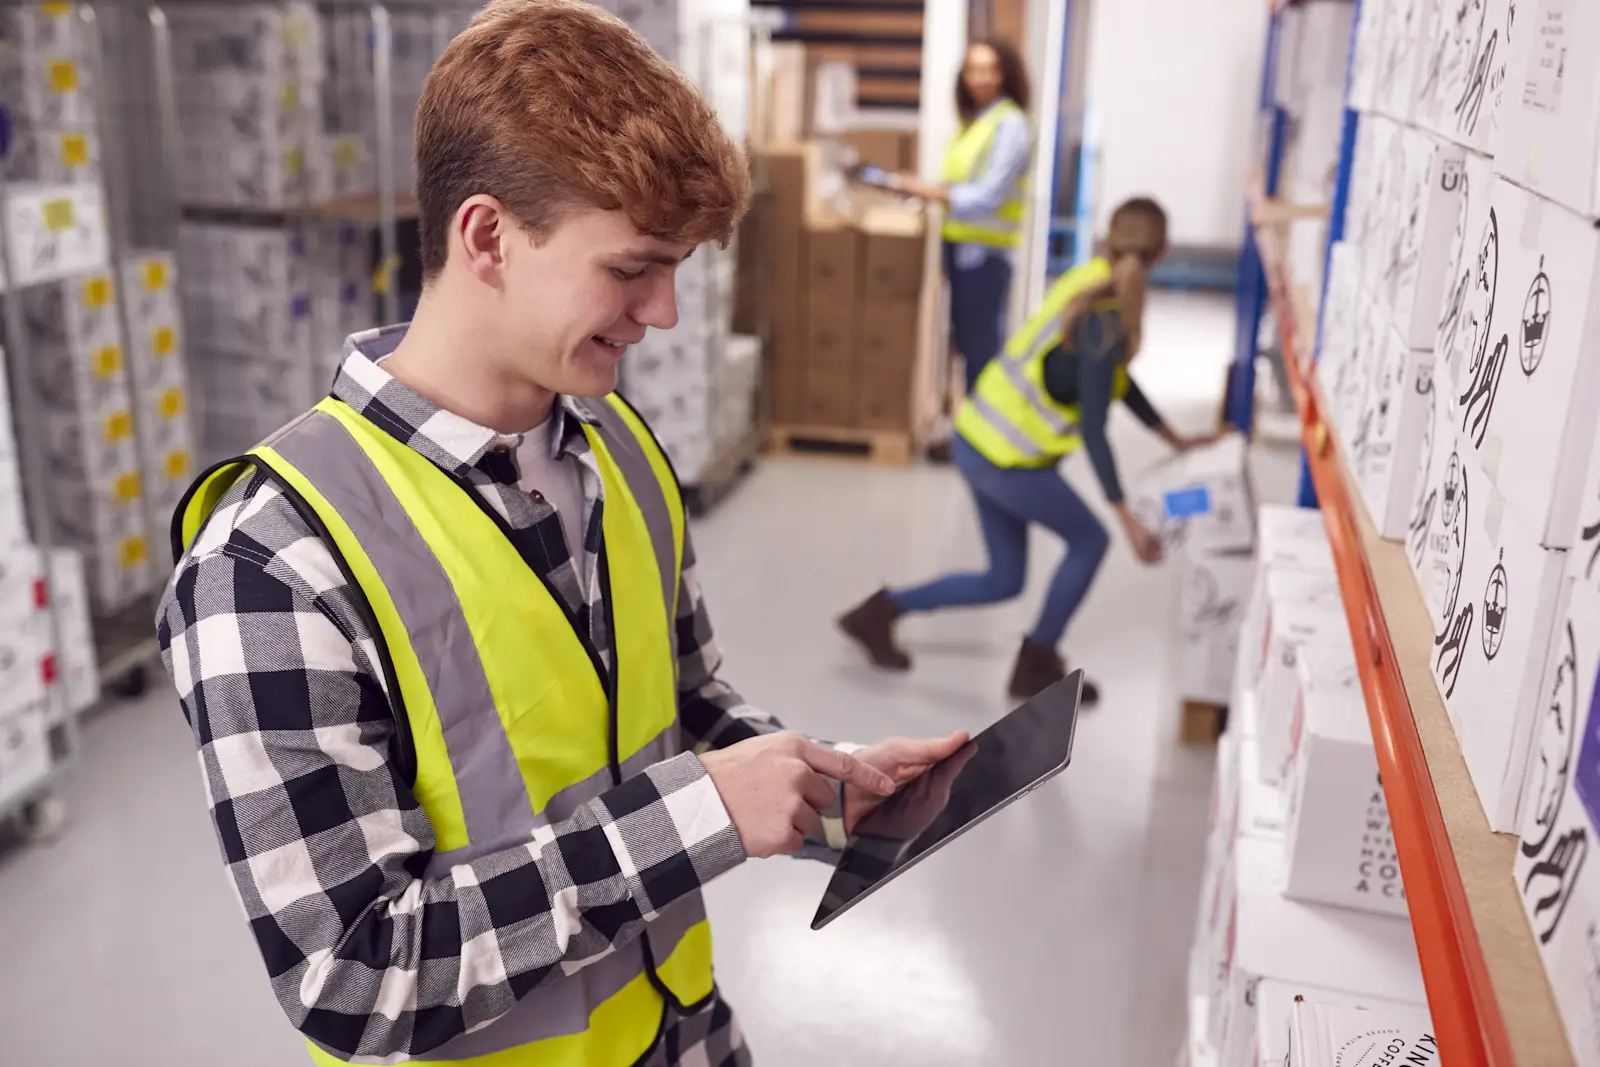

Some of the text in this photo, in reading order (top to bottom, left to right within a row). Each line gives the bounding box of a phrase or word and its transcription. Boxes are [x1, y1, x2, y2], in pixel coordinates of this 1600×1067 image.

[1491, 62, 1507, 92] KIN
[1359, 861, 1397, 881] CO
[1399, 1033, 1438, 1067] KIN
